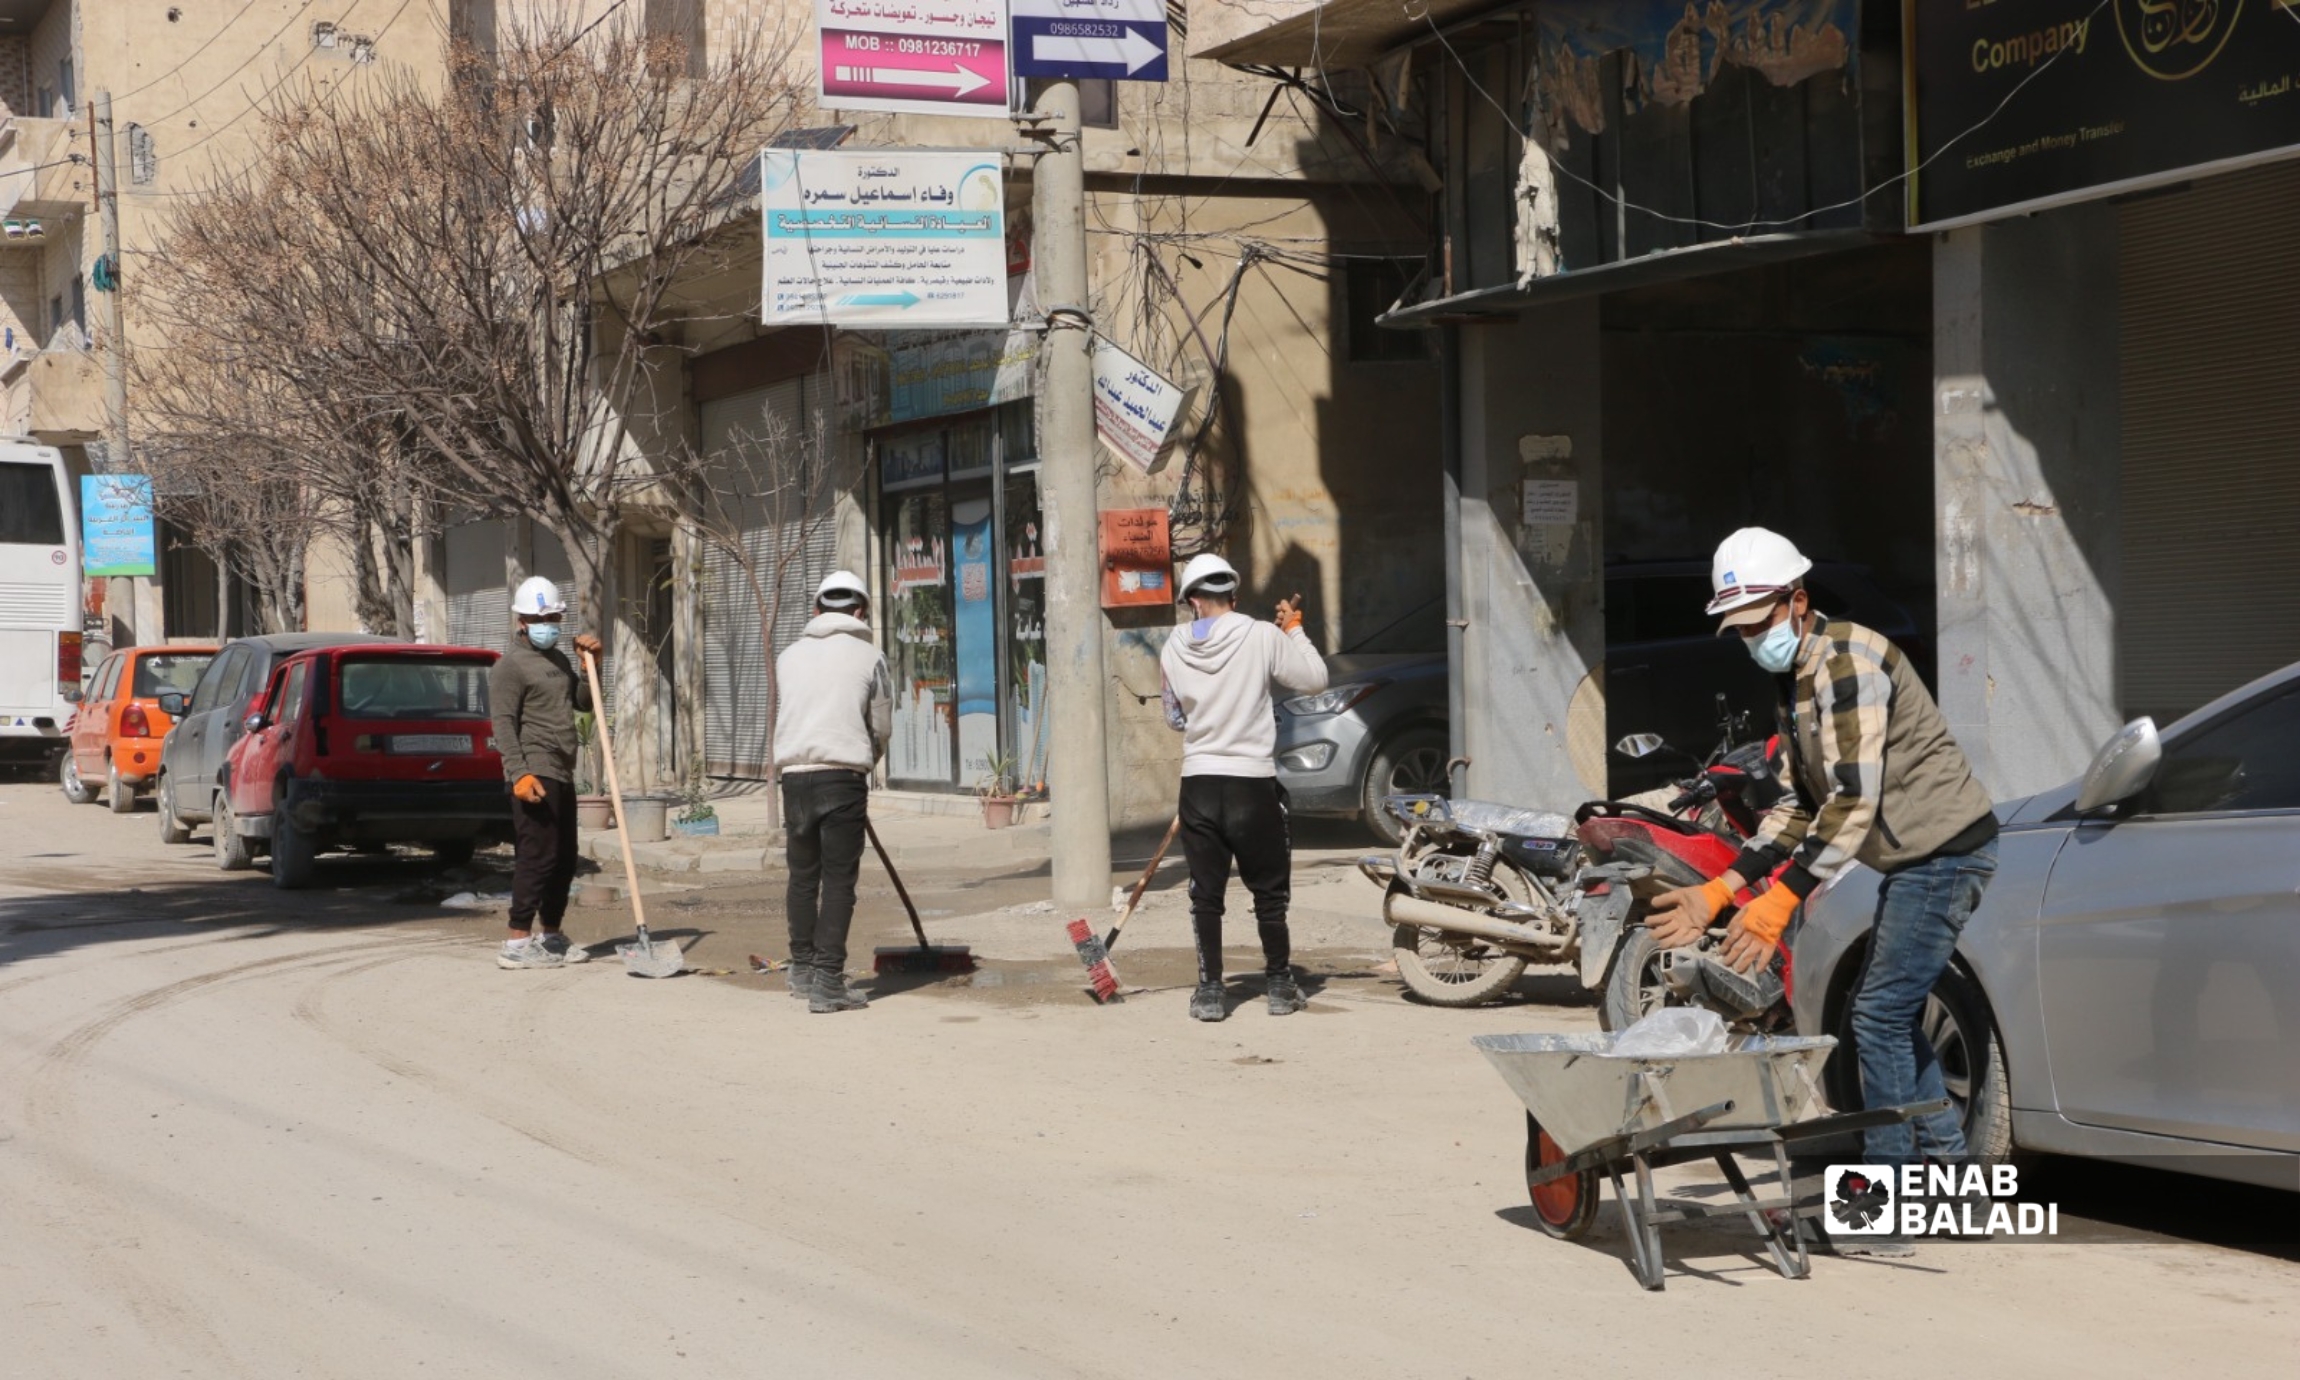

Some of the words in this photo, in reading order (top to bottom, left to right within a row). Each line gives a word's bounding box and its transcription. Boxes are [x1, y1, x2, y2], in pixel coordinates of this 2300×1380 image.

[831, 1, 871, 19] متحركة
[874, 4, 917, 24] تعويضات
[924, 12, 965, 27] وجسور
[967, 10, 997, 29] تيجان
[1050, 22, 1119, 37] 0986582532
[845, 34, 880, 51] MOB
[898, 37, 981, 58] 0981236717
[1971, 15, 2090, 74] Company
[2238, 73, 2290, 107] المالية
[1966, 144, 2017, 170] Exchange
[2019, 139, 2039, 157] and
[2040, 130, 2077, 152] Money
[2080, 119, 2126, 142] Transfer
[857, 165, 900, 178] الدكتورة
[921, 184, 954, 205] وفاء
[778, 212, 855, 235] التخصصية
[858, 213, 929, 234] النسائية
[930, 214, 993, 234] العيادة
[1124, 369, 1163, 396] الدكتور
[1118, 515, 1158, 528] مولدات
